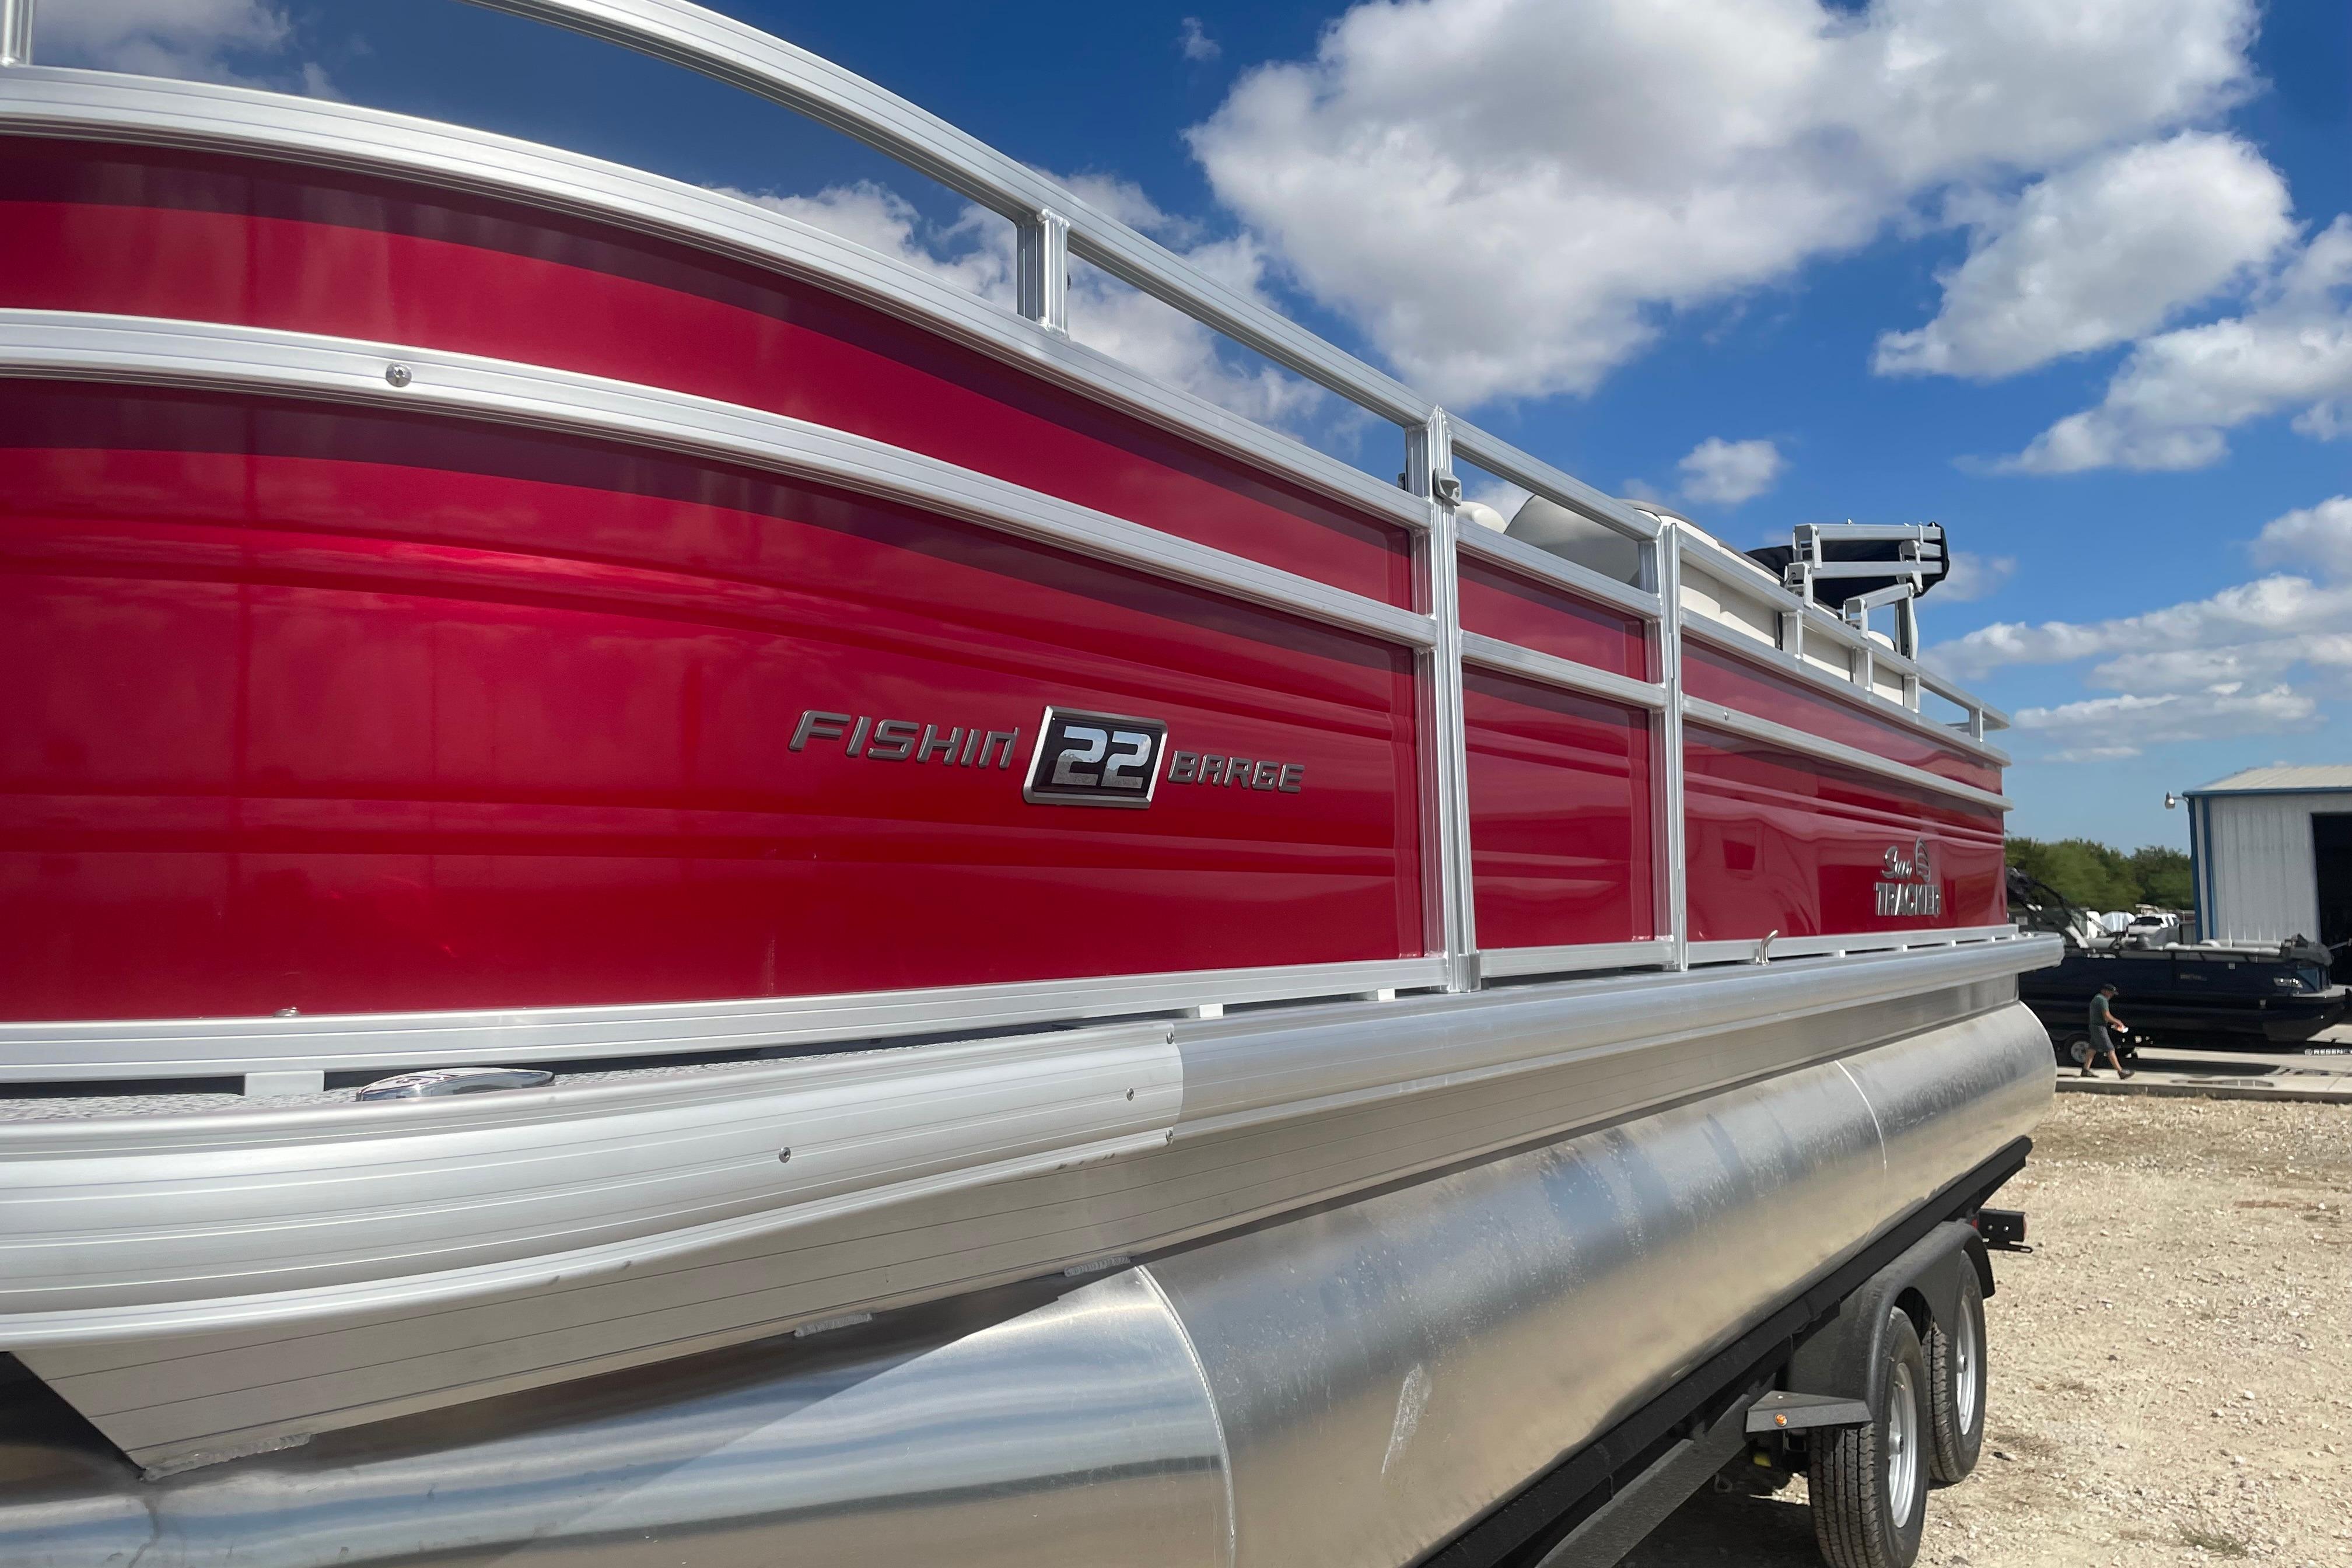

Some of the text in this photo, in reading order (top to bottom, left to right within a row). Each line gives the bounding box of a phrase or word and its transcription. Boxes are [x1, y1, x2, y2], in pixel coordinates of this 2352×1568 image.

[1051, 725, 1152, 789] 22
[1167, 750, 1306, 793] BARGE
[1881, 845, 1913, 880] Sun
[1874, 882, 1941, 916] TRACKER
